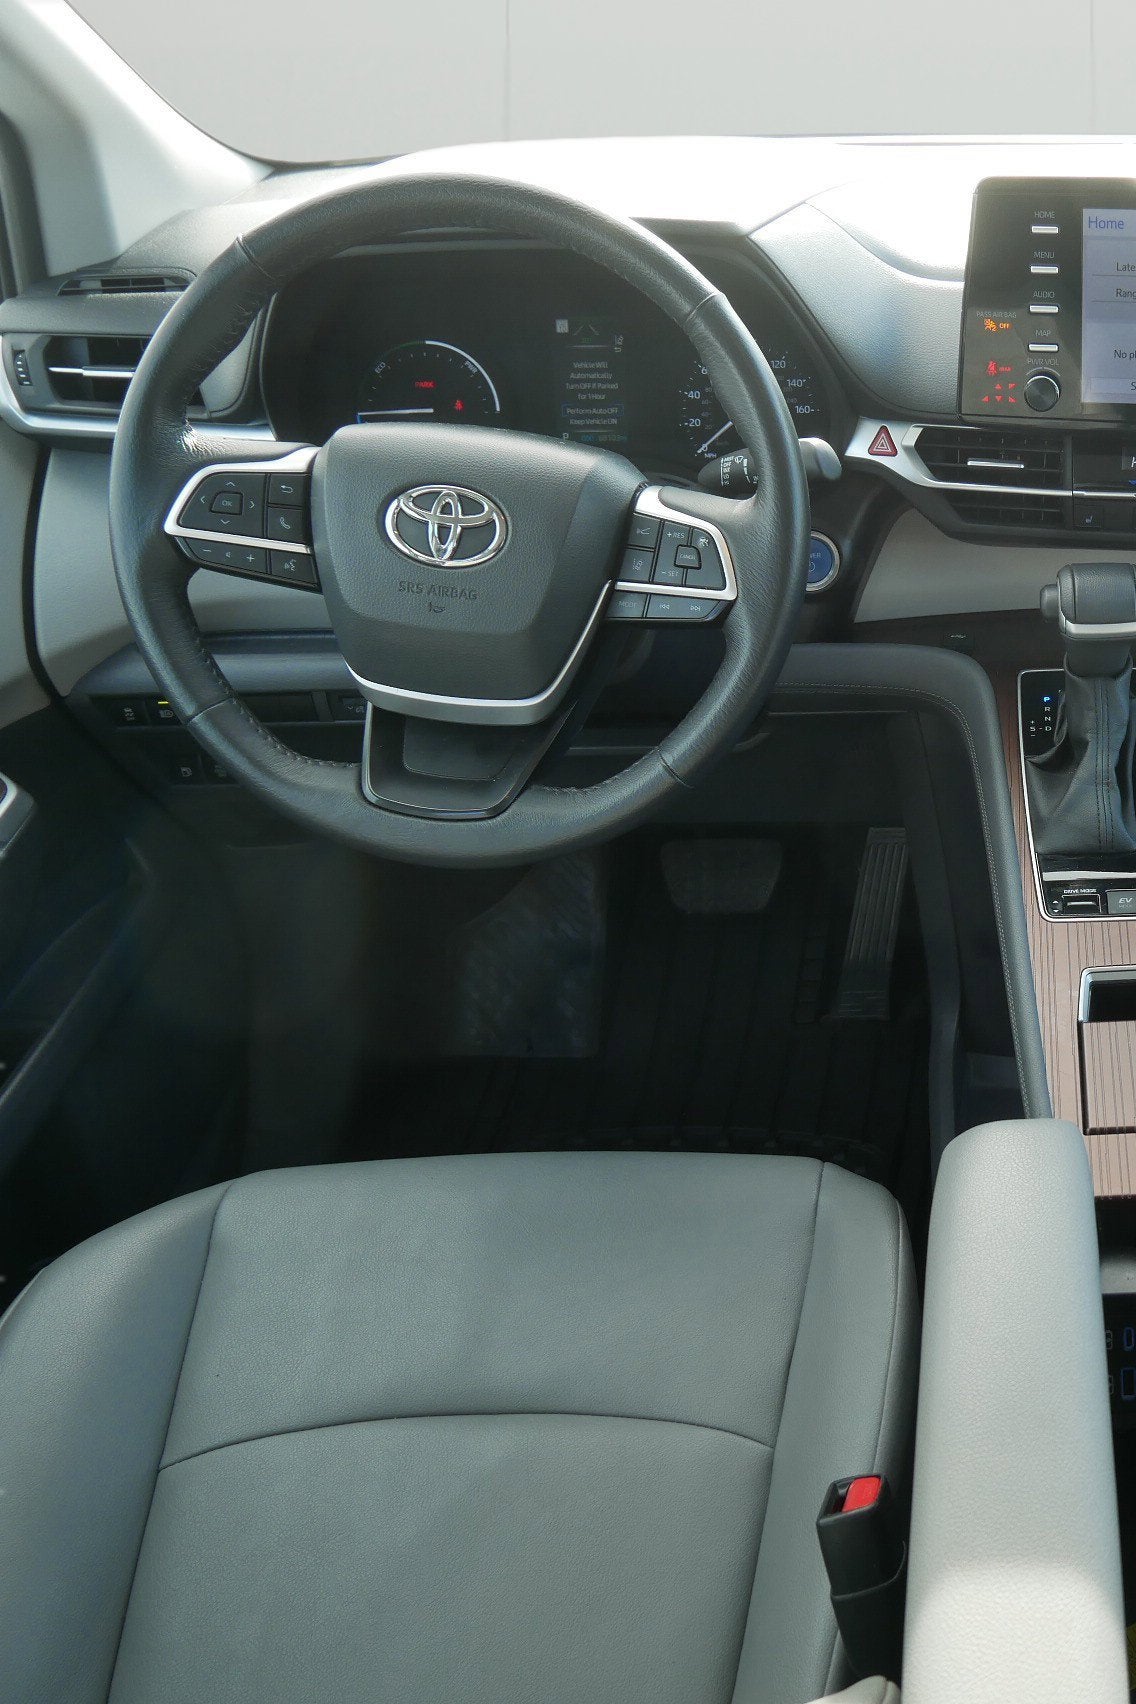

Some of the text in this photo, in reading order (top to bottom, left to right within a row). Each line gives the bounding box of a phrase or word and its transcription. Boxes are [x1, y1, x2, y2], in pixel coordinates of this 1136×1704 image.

[1034, 210, 1055, 219] HOME
[1087, 215, 1125, 230] Home
[1033, 251, 1055, 259] MENU
[1033, 290, 1055, 299] AUDIO
[1035, 329, 1051, 337] MAP
[1114, 350, 1127, 359] No
[374, 361, 386, 374] ECO
[770, 360, 786, 369] 120
[787, 379, 803, 388] 140
[688, 390, 701, 400] 40
[795, 405, 811, 414] 160
[689, 418, 701, 427] 20
[398, 580, 478, 601] SRS AIRBAG
